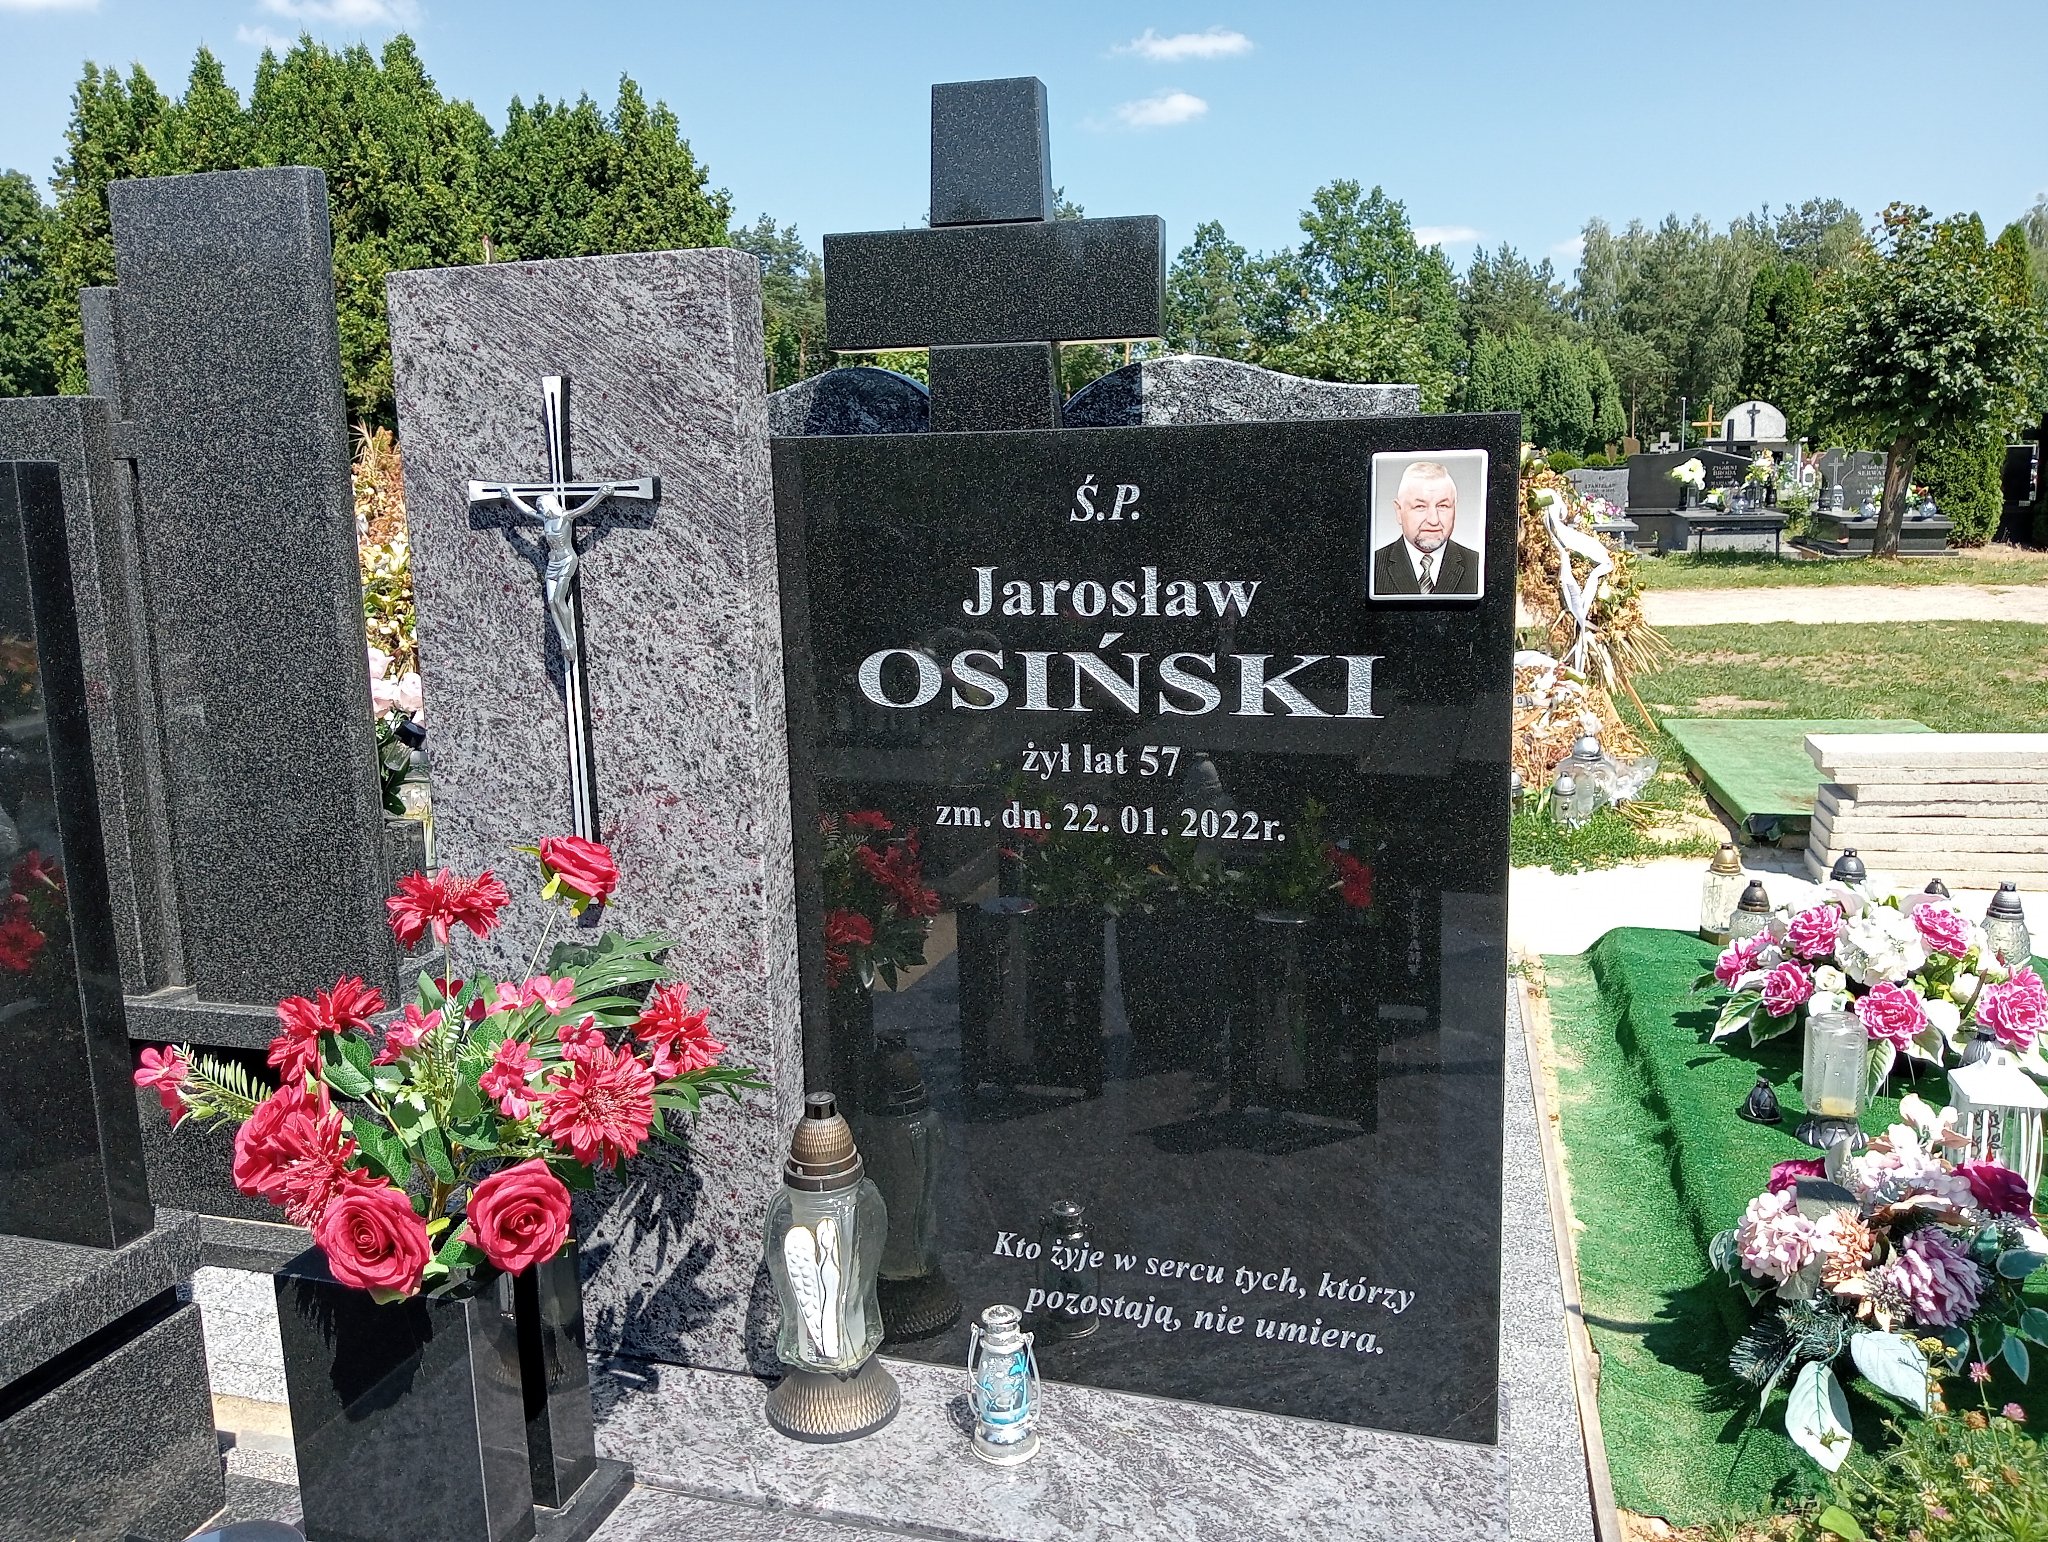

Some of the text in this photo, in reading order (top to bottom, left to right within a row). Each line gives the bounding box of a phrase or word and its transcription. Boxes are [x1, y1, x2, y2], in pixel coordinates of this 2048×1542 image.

[1069, 473, 1141, 522] Ś.P.
[962, 565, 1260, 617] Jarosław
[857, 632, 1386, 719] OSIŃSKI
[1022, 741, 1181, 780] żył lat 57
[935, 801, 1287, 842] zm. dn. 22. 01. 2022r.
[993, 1231, 1417, 1314] Kto żyje w sercu tych, którzy
[1024, 1286, 1385, 1356] pozostają, nie umiera.
